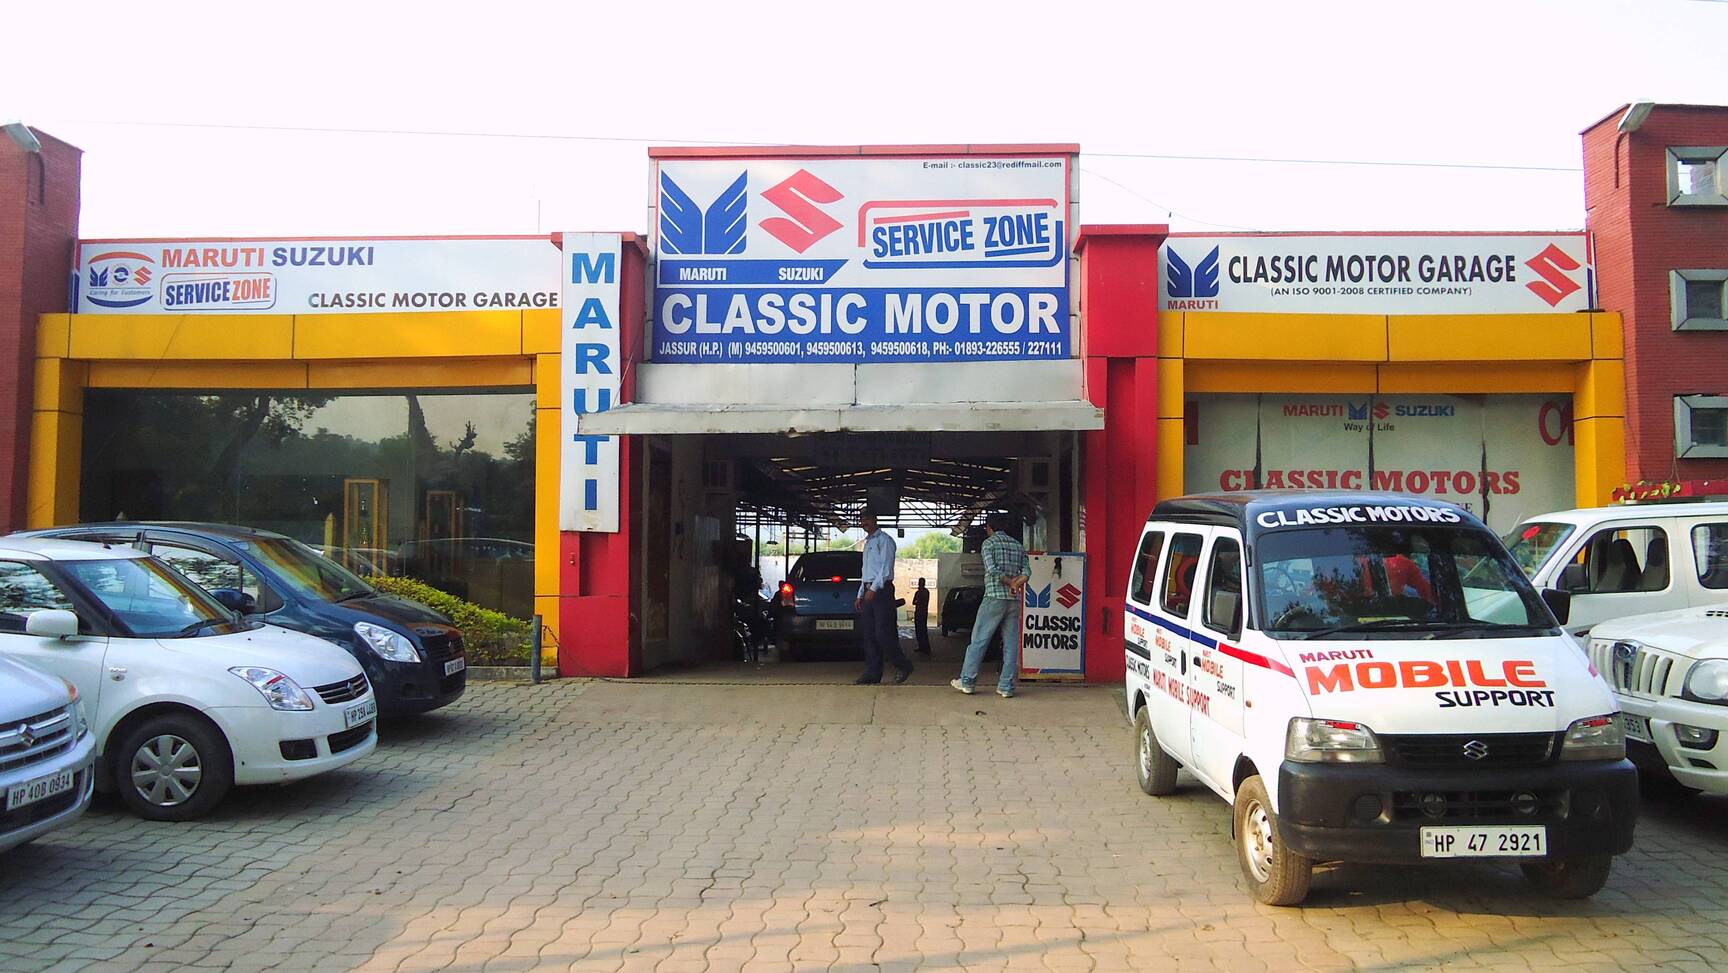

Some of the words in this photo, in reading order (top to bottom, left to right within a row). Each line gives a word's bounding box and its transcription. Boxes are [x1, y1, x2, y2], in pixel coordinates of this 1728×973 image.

[923, 161, 948, 169] E-mail
[873, 220, 974, 258] SERVICE
[984, 213, 1050, 248] ZONE
[162, 248, 265, 268] MARUTI
[272, 247, 374, 267] SUZUKI
[679, 266, 727, 282] MARUTI
[778, 266, 824, 282] SUZUKI
[1228, 255, 1318, 284] CLASSIC
[1325, 254, 1411, 283] MOTOR
[1418, 254, 1516, 283] GARAGE
[165, 281, 230, 306] SERVICE
[232, 278, 271, 301] ZONE
[308, 293, 386, 308] CLASSIC
[392, 292, 467, 308] MOTOR
[473, 292, 558, 307] GARAGE
[1271, 287, 1290, 297] (AN
[1292, 287, 1310, 296] ISO
[1312, 287, 1364, 296] 9001-2008
[1367, 287, 1414, 296] CERTIFIED
[1416, 287, 1472, 297] COMPANY)
[662, 293, 868, 334] CLASSIC
[885, 292, 1061, 334] MOTOR
[1168, 300, 1218, 310] MARUTI
[659, 342, 697, 355] JASSUR
[699, 341, 723, 358] (H.P.)
[728, 341, 743, 358] (M)
[745, 341, 804, 358] 9459500601,
[806, 341, 866, 358] 9459500613,
[871, 341, 930, 358] 9459500618,
[955, 341, 1020, 355] 01893-226555
[1027, 341, 1062, 355] 227111
[571, 252, 613, 511] MARUTI
[1283, 405, 1344, 416] MARUTI
[1395, 405, 1456, 416] SUZUKI
[1344, 422, 1362, 433] Way
[1378, 422, 1395, 432] Life
[1220, 469, 1362, 492] CLASSIC
[1373, 470, 1521, 495] MOTORS
[1257, 507, 1367, 528] CLASSIC
[1368, 506, 1461, 523] MOTORS
[1026, 614, 1080, 632] CLASSIC
[1023, 633, 1079, 650] MOTORS
[1299, 649, 1375, 663] MARUTI
[1202, 657, 1224, 680] MOBILE
[1305, 660, 1547, 695] MOBILE
[1168, 675, 1185, 703] MOBILE
[1186, 685, 1210, 717] SUPPORT
[1216, 680, 1236, 700] SUPPORT
[1435, 690, 1555, 708] SUPPORT
[12, 788, 26, 806] HP
[28, 781, 47, 800] 40B
[49, 772, 70, 793] 0934
[1434, 834, 1455, 852] HP
[1467, 834, 1488, 852] 47
[1498, 833, 1540, 851] 2921
